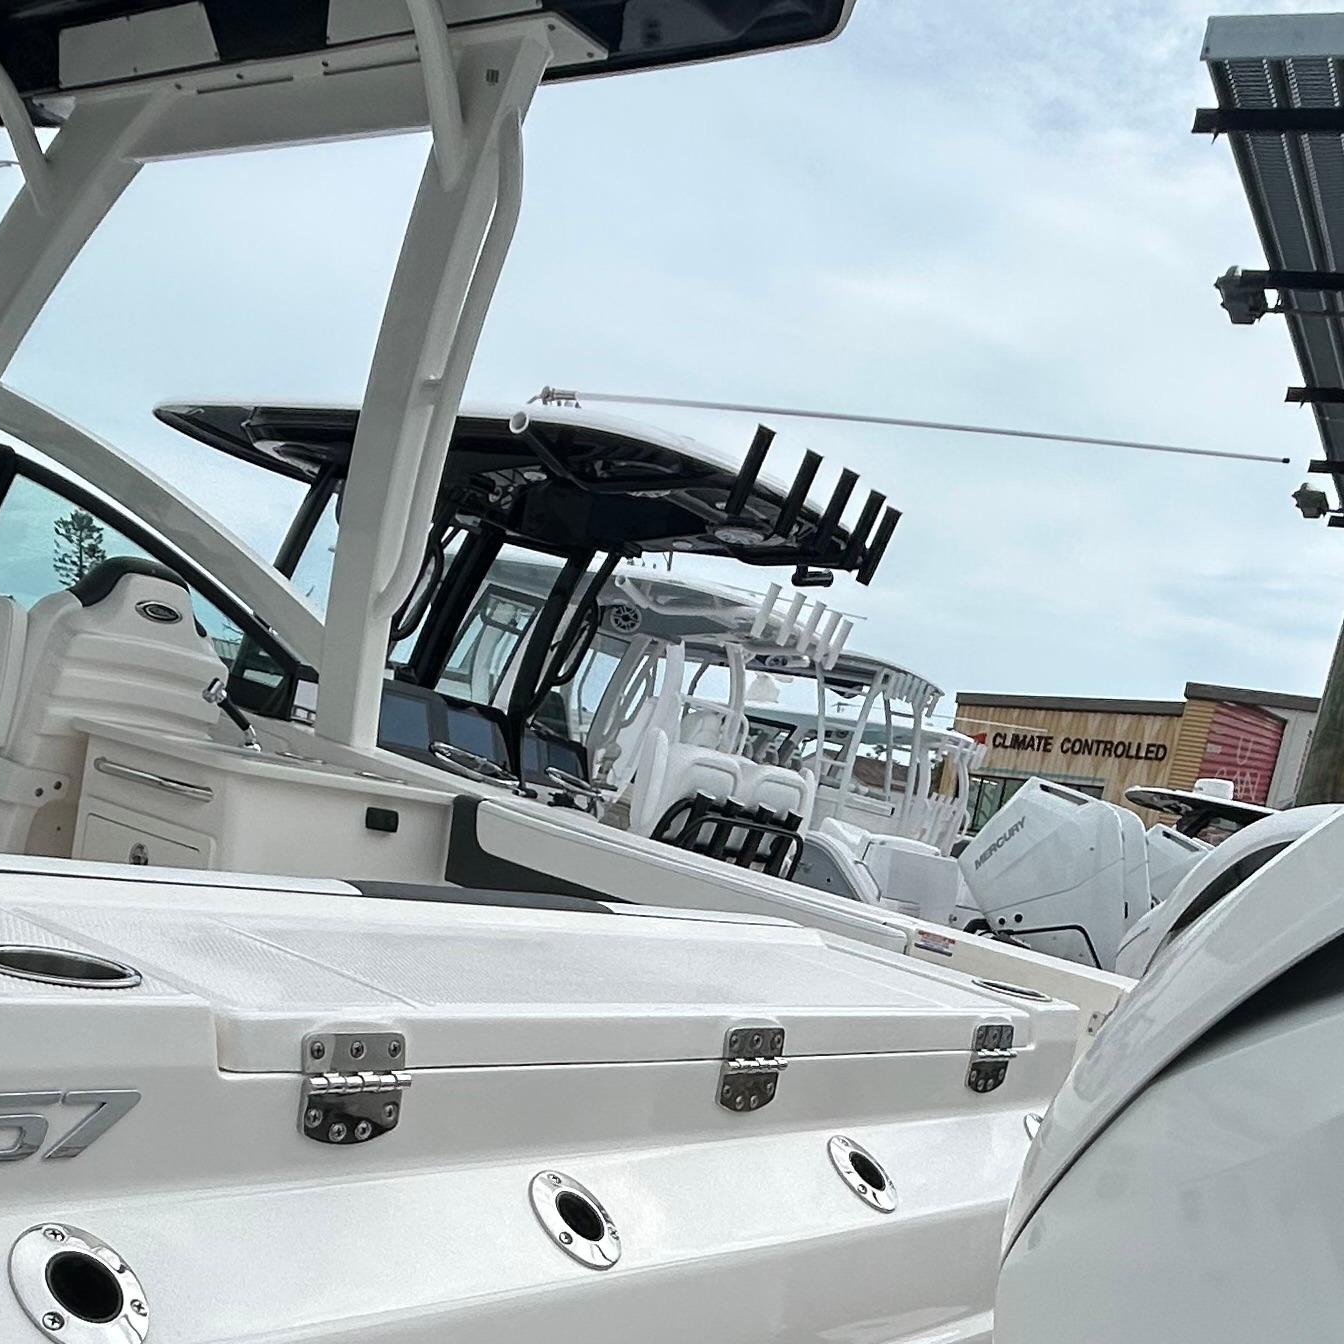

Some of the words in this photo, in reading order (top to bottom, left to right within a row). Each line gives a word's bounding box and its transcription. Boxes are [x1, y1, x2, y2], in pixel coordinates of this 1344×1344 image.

[992, 732, 1054, 753] CLIMATE
[1060, 737, 1168, 762] CONTROLLED
[974, 815, 1026, 871] MERCURY
